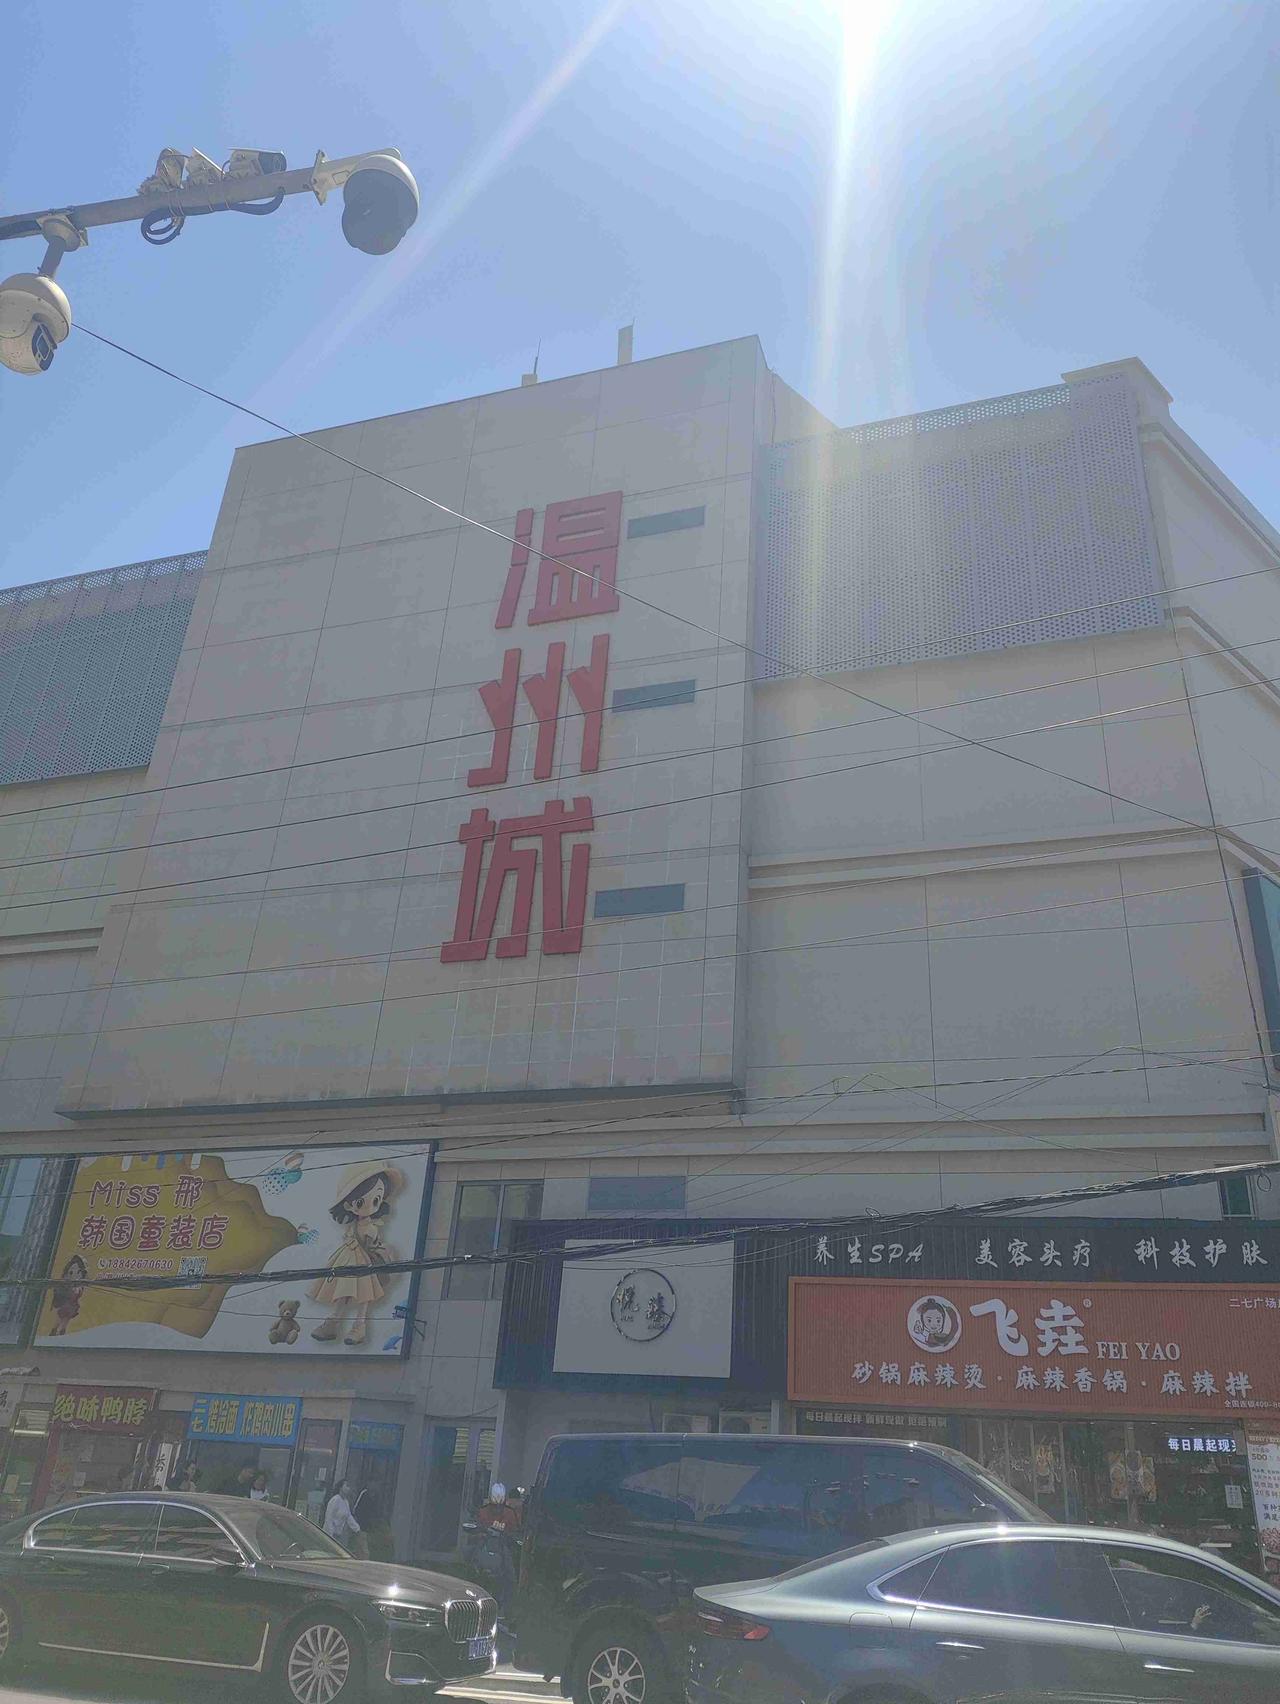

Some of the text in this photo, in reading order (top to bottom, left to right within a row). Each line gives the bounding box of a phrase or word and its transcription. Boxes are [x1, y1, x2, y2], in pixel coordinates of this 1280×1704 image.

[440, 490, 622, 963] 温州城
[89, 1179, 160, 1208] Miss
[78, 1213, 230, 1251] 韩国童装店
[975, 1238, 1091, 1269] 美容头疗
[1134, 1236, 1268, 1271] 科技护肤
[1229, 1297, 1280, 1309] 二七广场
[969, 1298, 1090, 1357] 飞垚
[1096, 1341, 1181, 1361] FEI YAO
[851, 1360, 1253, 1398] 砂锅麻辣烫 麻辣香锅 麻辣拌
